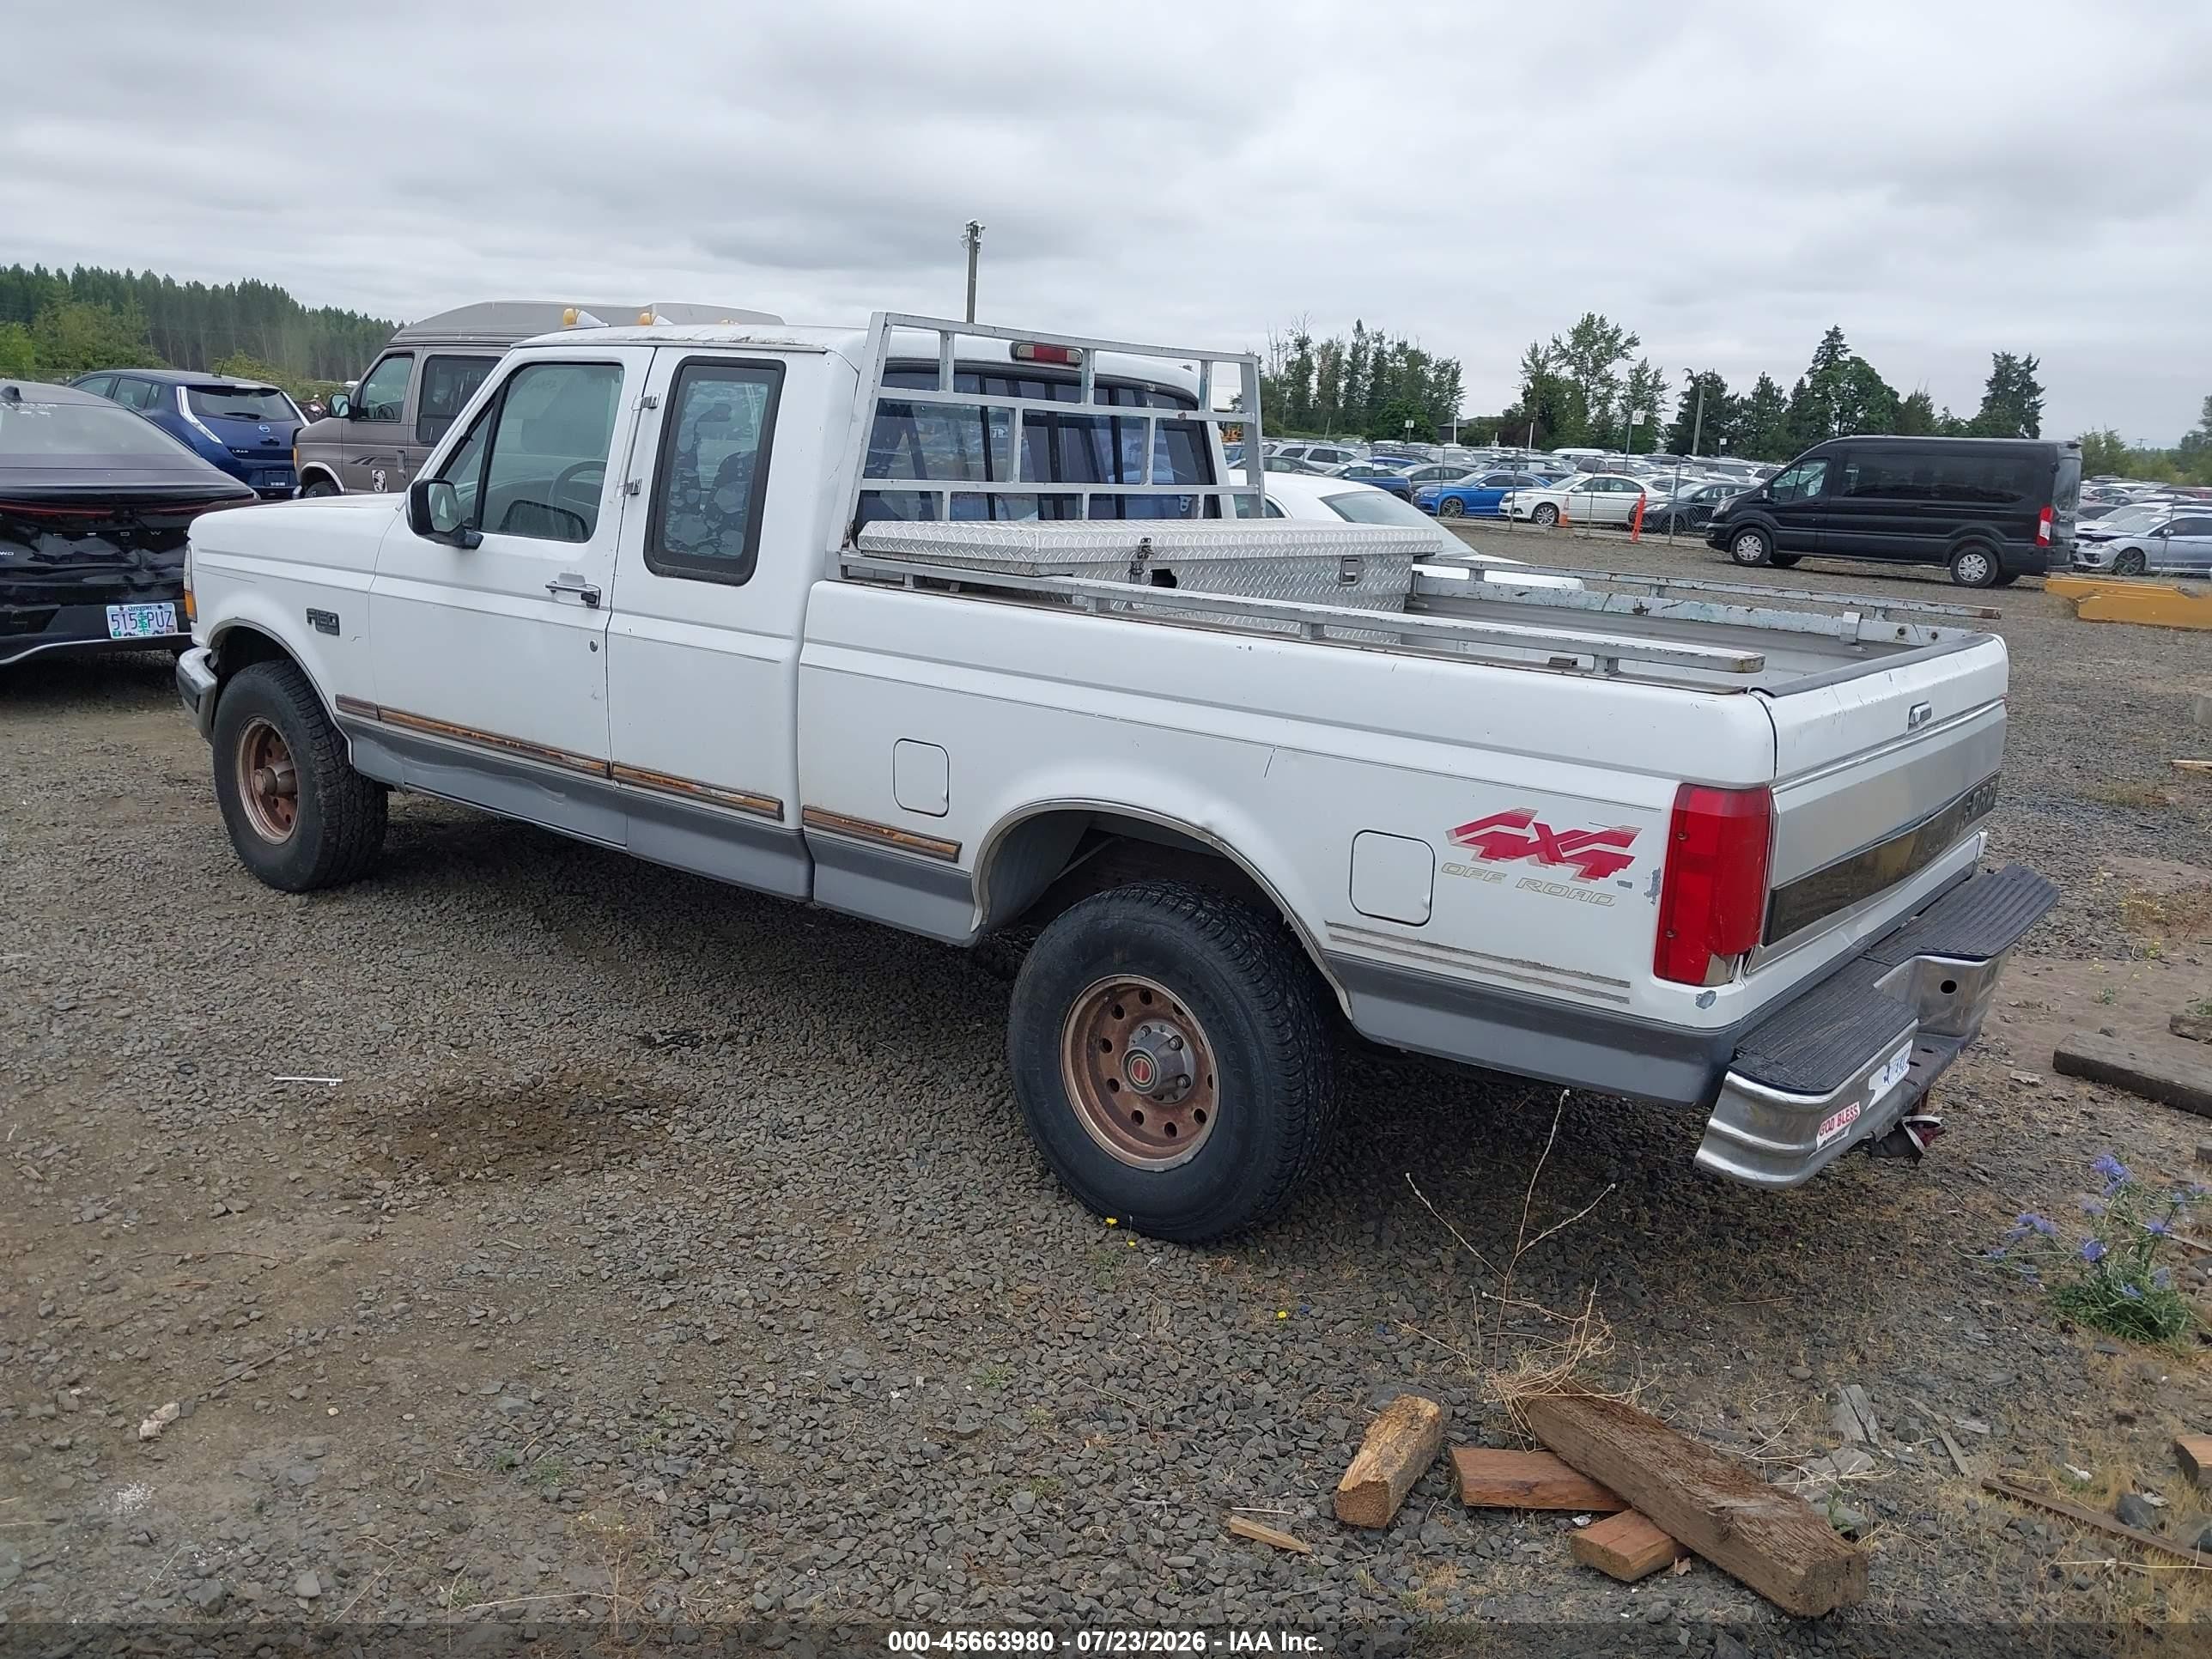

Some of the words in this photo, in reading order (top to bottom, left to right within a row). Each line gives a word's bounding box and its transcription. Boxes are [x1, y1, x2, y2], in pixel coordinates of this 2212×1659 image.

[1632, 412, 1643, 423] 40
[111, 612, 138, 630] 515
[147, 611, 174, 629] PUZ
[1441, 861, 1508, 885] OFF
[1515, 877, 1616, 908] ROAD
[1819, 1117, 1835, 1137] GOD
[1836, 1104, 1859, 1127] BLESS
